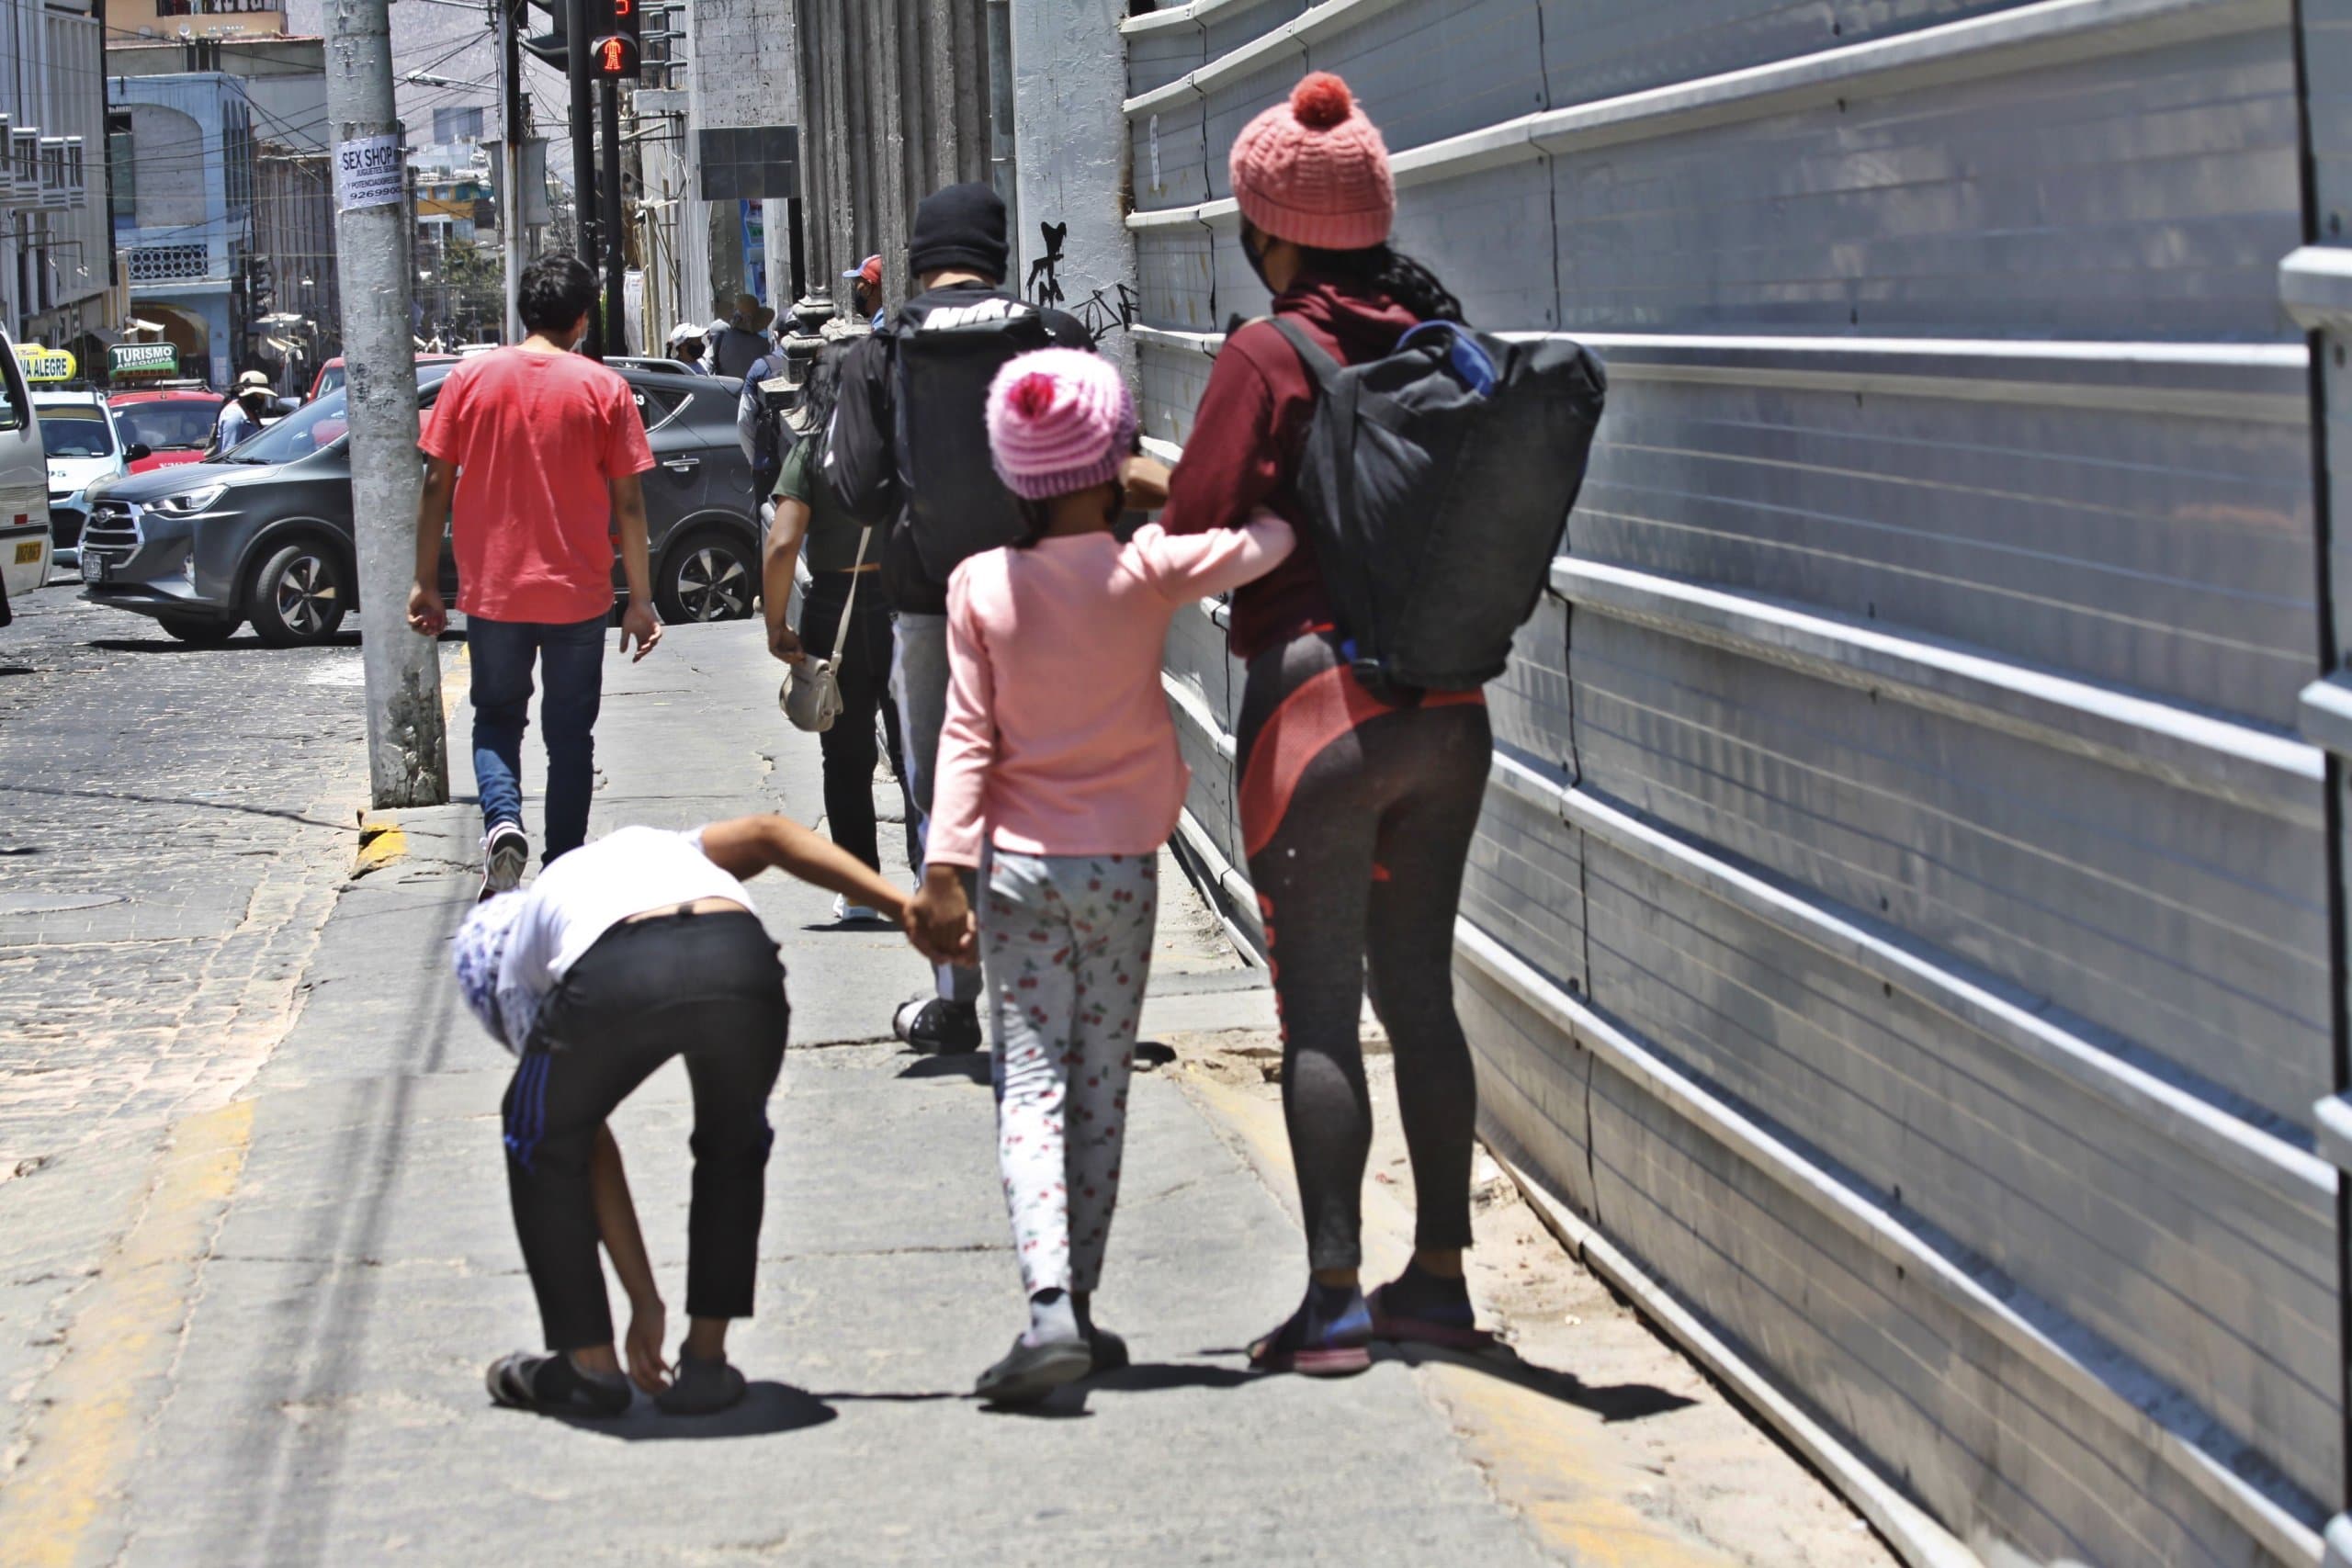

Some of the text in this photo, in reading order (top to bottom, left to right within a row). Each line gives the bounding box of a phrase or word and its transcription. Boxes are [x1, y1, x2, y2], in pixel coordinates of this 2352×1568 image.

[343, 150, 363, 171] SEX
[365, 146, 392, 167] SHOP
[356, 166, 383, 177] JUGUETES
[114, 346, 172, 363] TURISMO
[116, 356, 172, 369] AREQUIPA
[33, 357, 67, 378] ALEGRE
